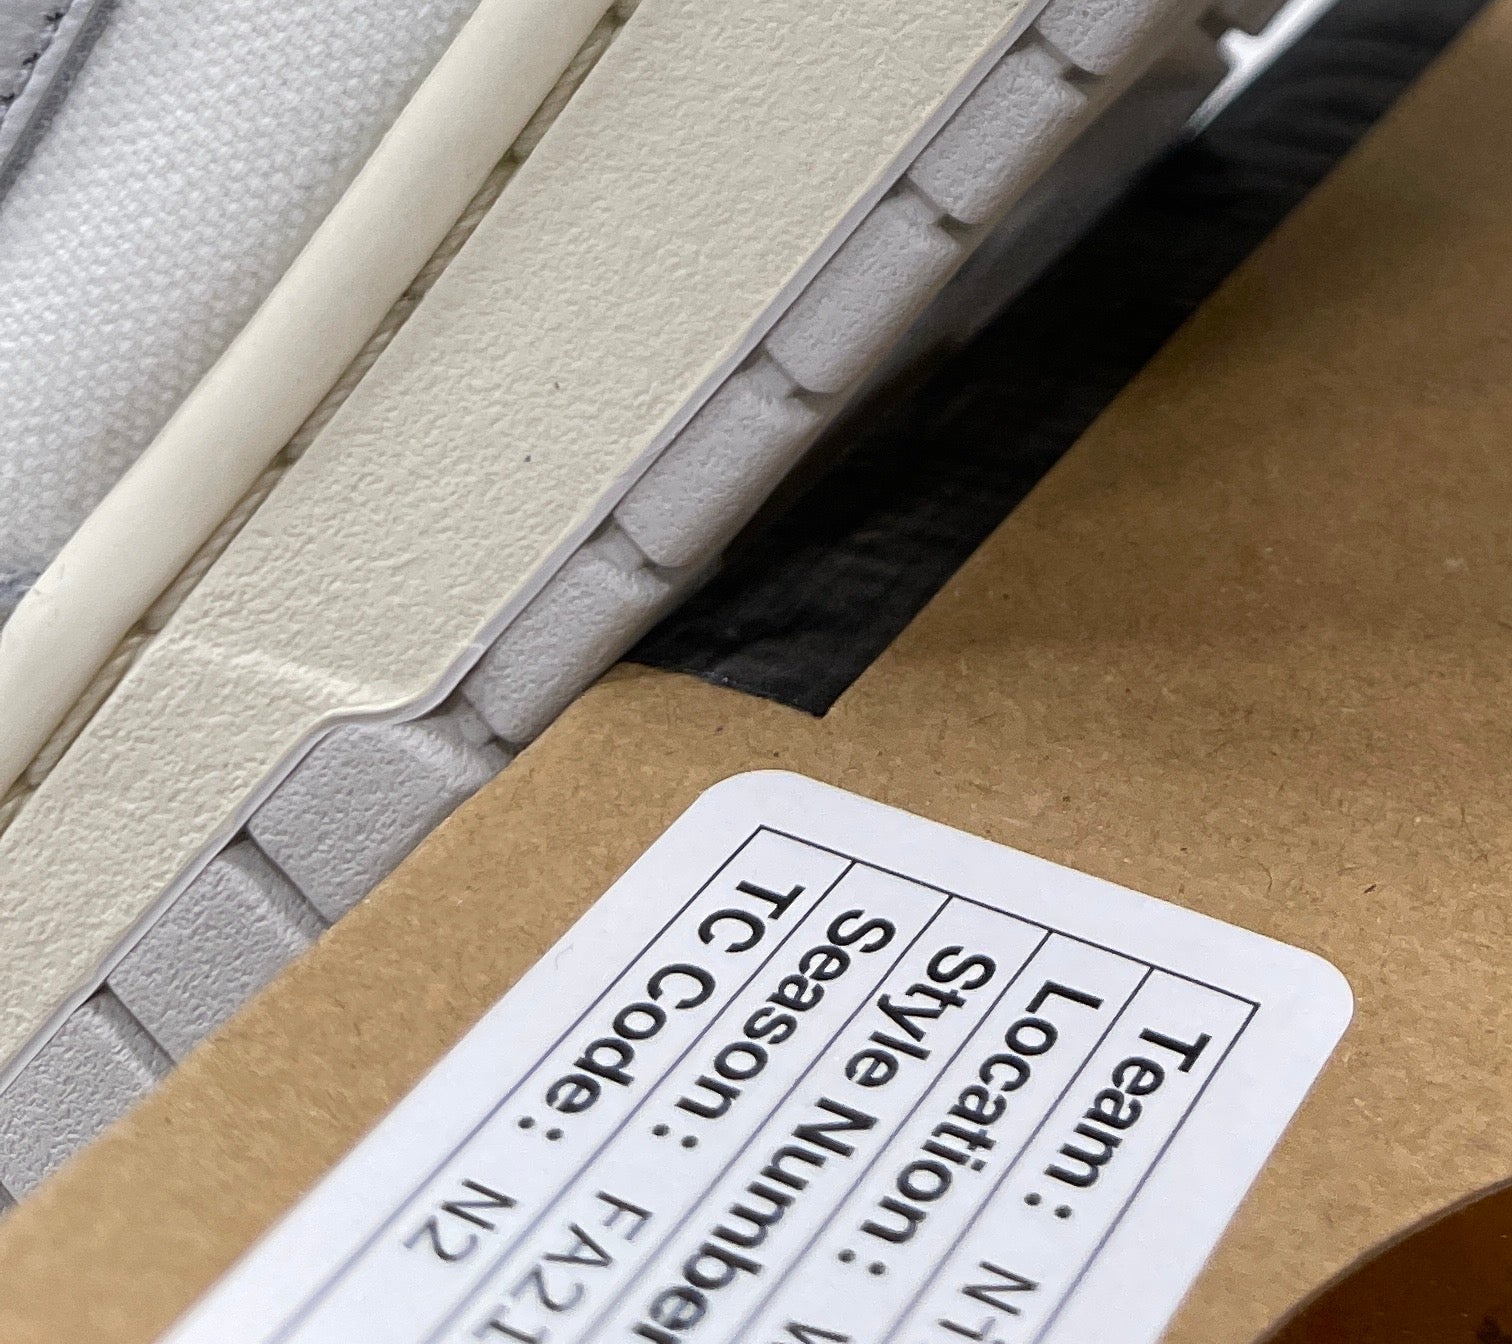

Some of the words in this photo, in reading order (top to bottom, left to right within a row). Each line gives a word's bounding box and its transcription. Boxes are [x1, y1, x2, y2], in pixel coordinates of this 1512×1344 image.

[697, 879, 805, 954] TC
[845, 945, 996, 1087] Style
[402, 1177, 517, 1262] N2
